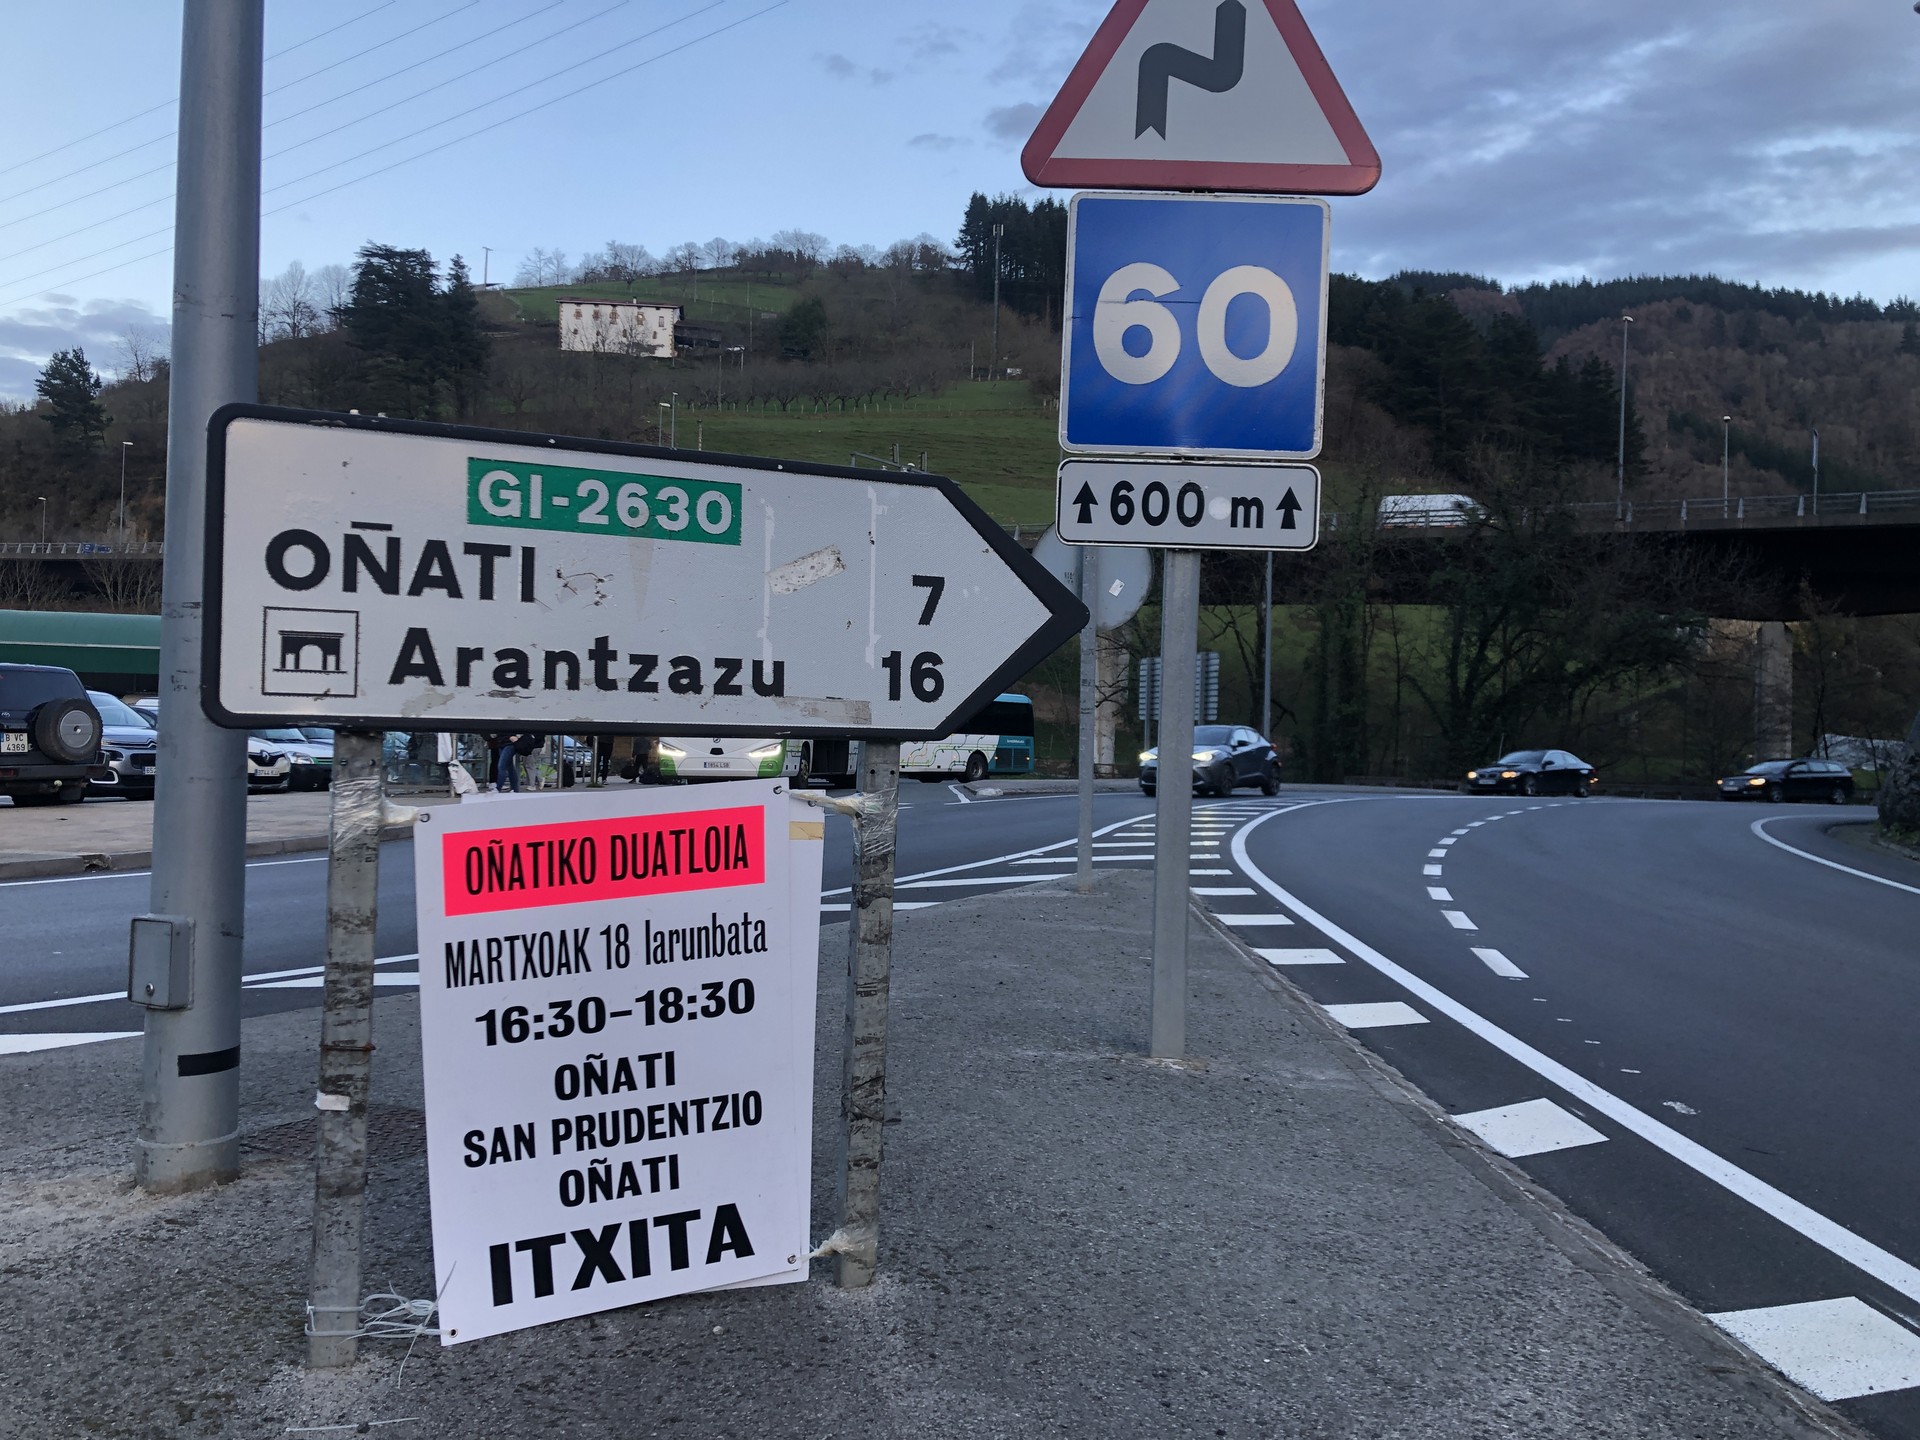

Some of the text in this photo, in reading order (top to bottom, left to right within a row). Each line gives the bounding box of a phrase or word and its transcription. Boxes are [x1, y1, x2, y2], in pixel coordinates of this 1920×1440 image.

[1093, 262, 1298, 387] 60
[477, 469, 733, 536] GI-2630
[1110, 480, 1264, 529] 600 m
[264, 521, 945, 626] OÑATI 7
[388, 627, 945, 703] Arantzazu 16
[465, 823, 750, 896] OÑATIKO DUATLOIA
[445, 912, 768, 989] MARTXOAK 18 larunbata
[554, 1051, 676, 1101] OÑATI
[463, 1090, 763, 1168] SAN PRUDENTZIO
[559, 1154, 680, 1208] OÑATI
[489, 1202, 755, 1307] ITXITA
